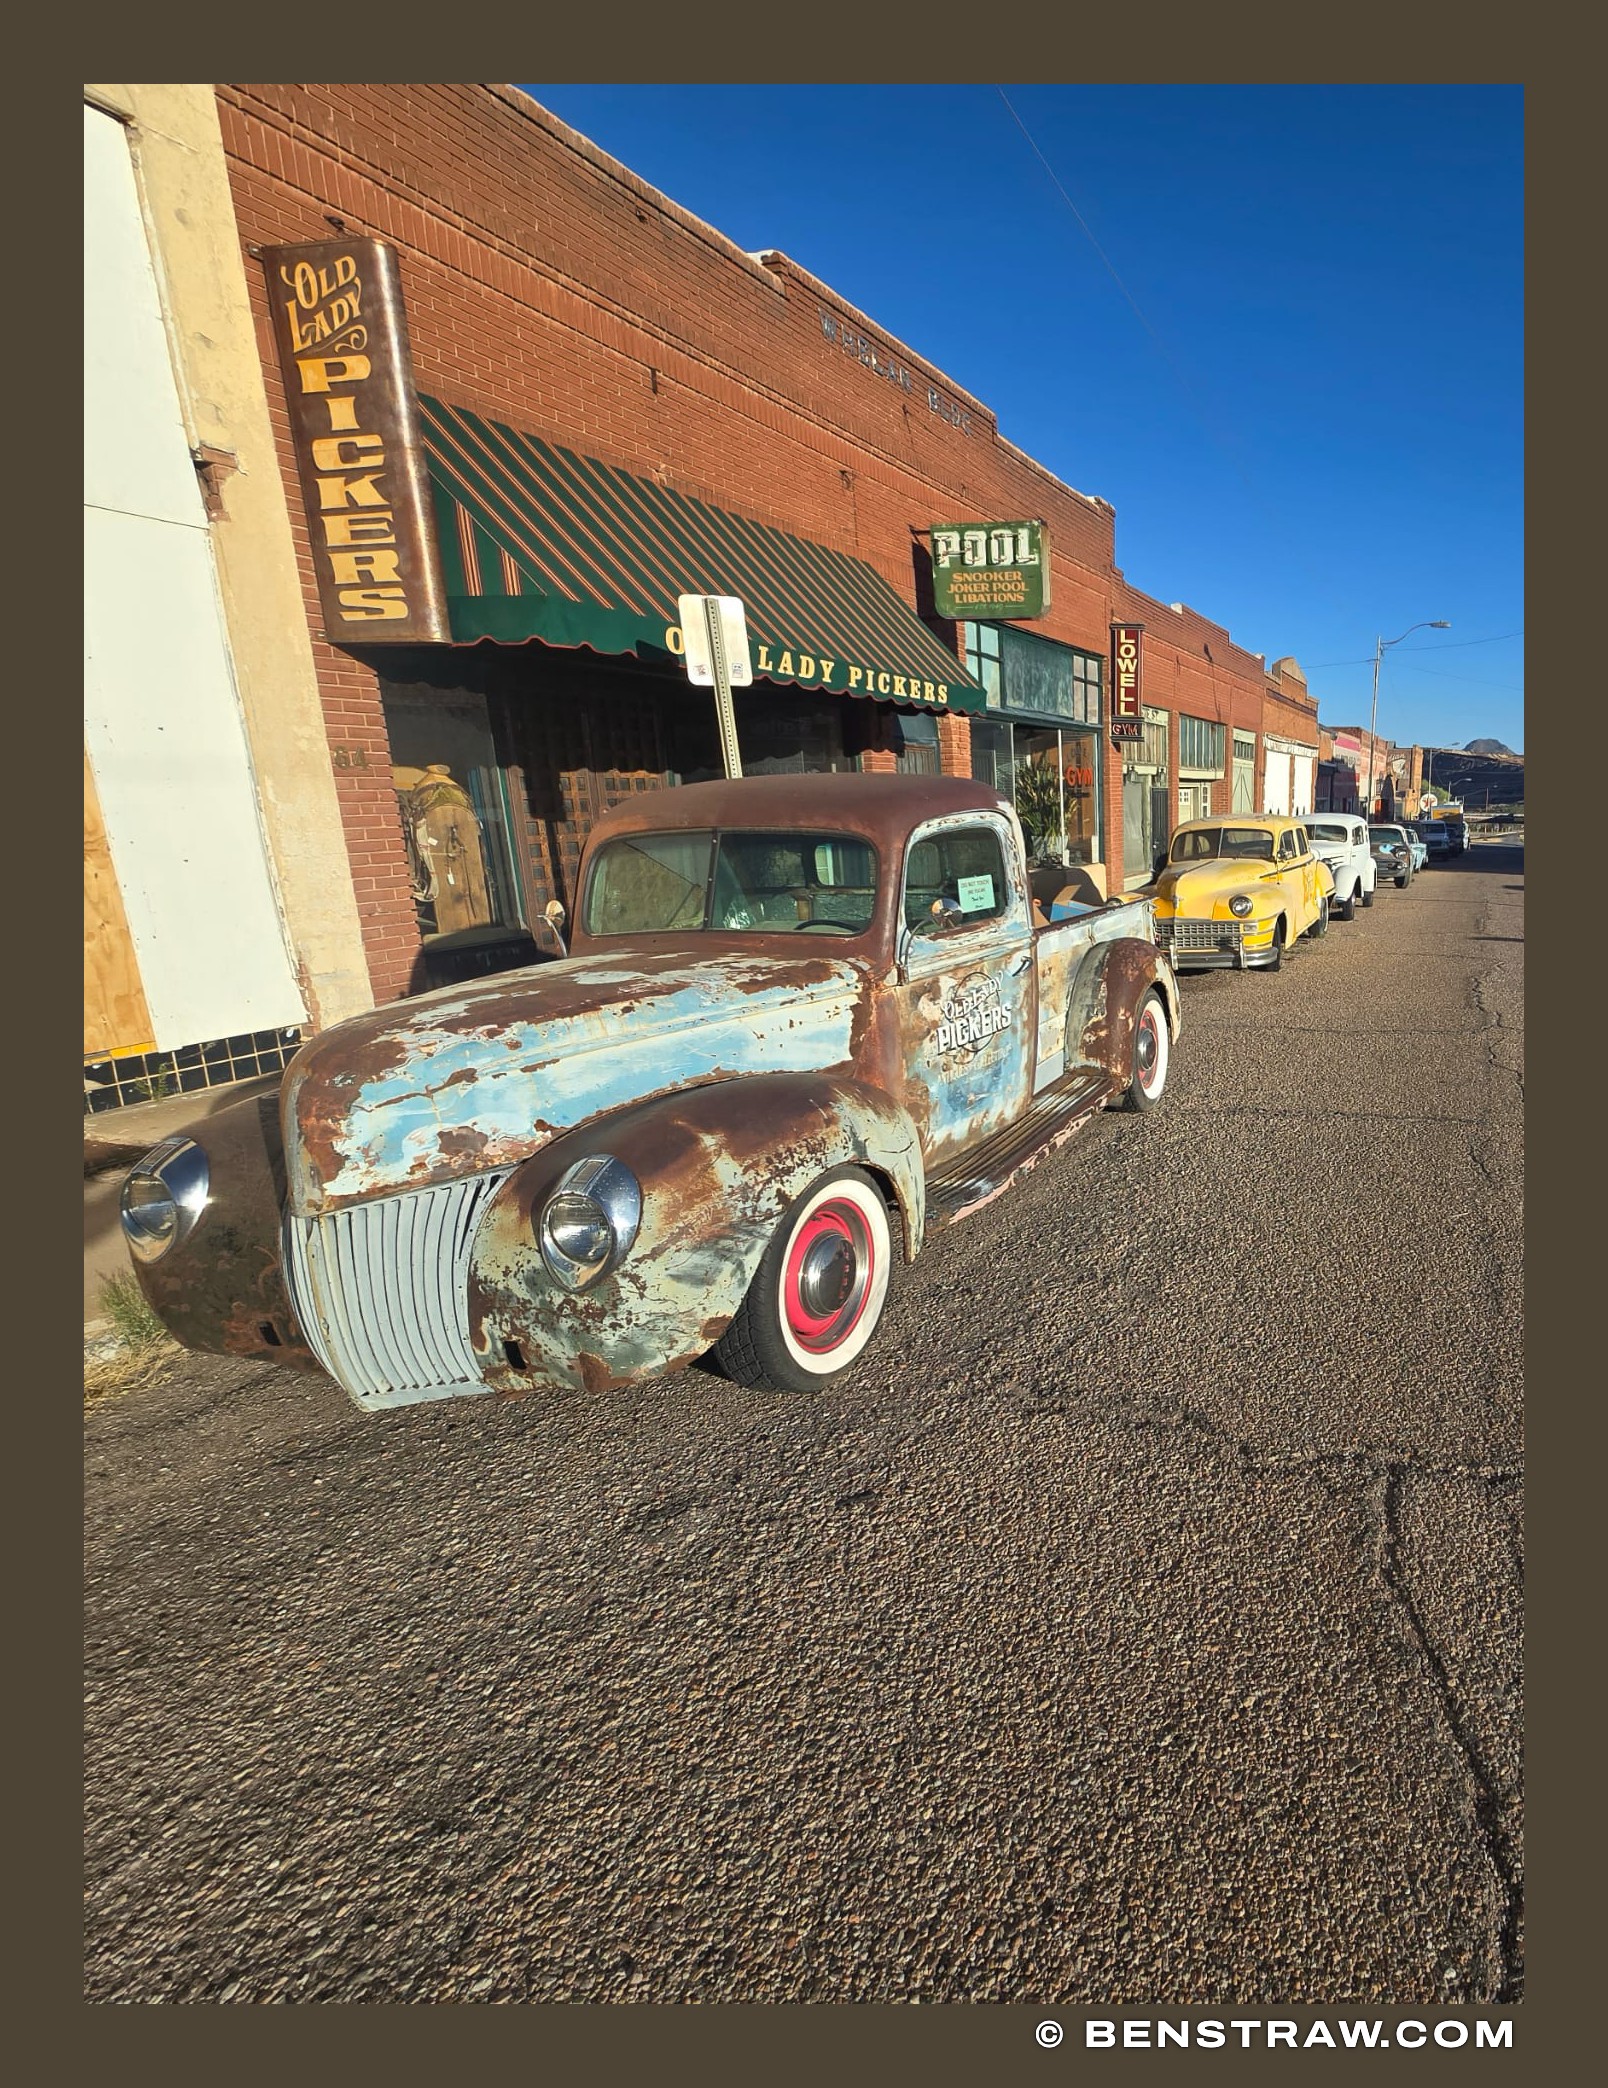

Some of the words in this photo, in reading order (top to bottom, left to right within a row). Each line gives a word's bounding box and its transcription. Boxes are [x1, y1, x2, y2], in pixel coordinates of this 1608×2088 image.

[281, 255, 357, 309] OLD
[285, 277, 362, 353] LADY
[297, 355, 409, 622] PICKERS
[933, 528, 1039, 568] POOL
[947, 583, 989, 594] JOKER
[992, 582, 1029, 592] POOL
[952, 571, 1022, 582] SNOOKER
[954, 592, 1025, 604] LIBATIONS
[757, 645, 835, 683] LADY
[848, 665, 949, 704] PICKERS
[1117, 629, 1138, 716] LOWELL
[1112, 723, 1138, 736] GYM
[1065, 765, 1093, 786] GYM
[937, 1003, 1012, 1055] PICKERS
